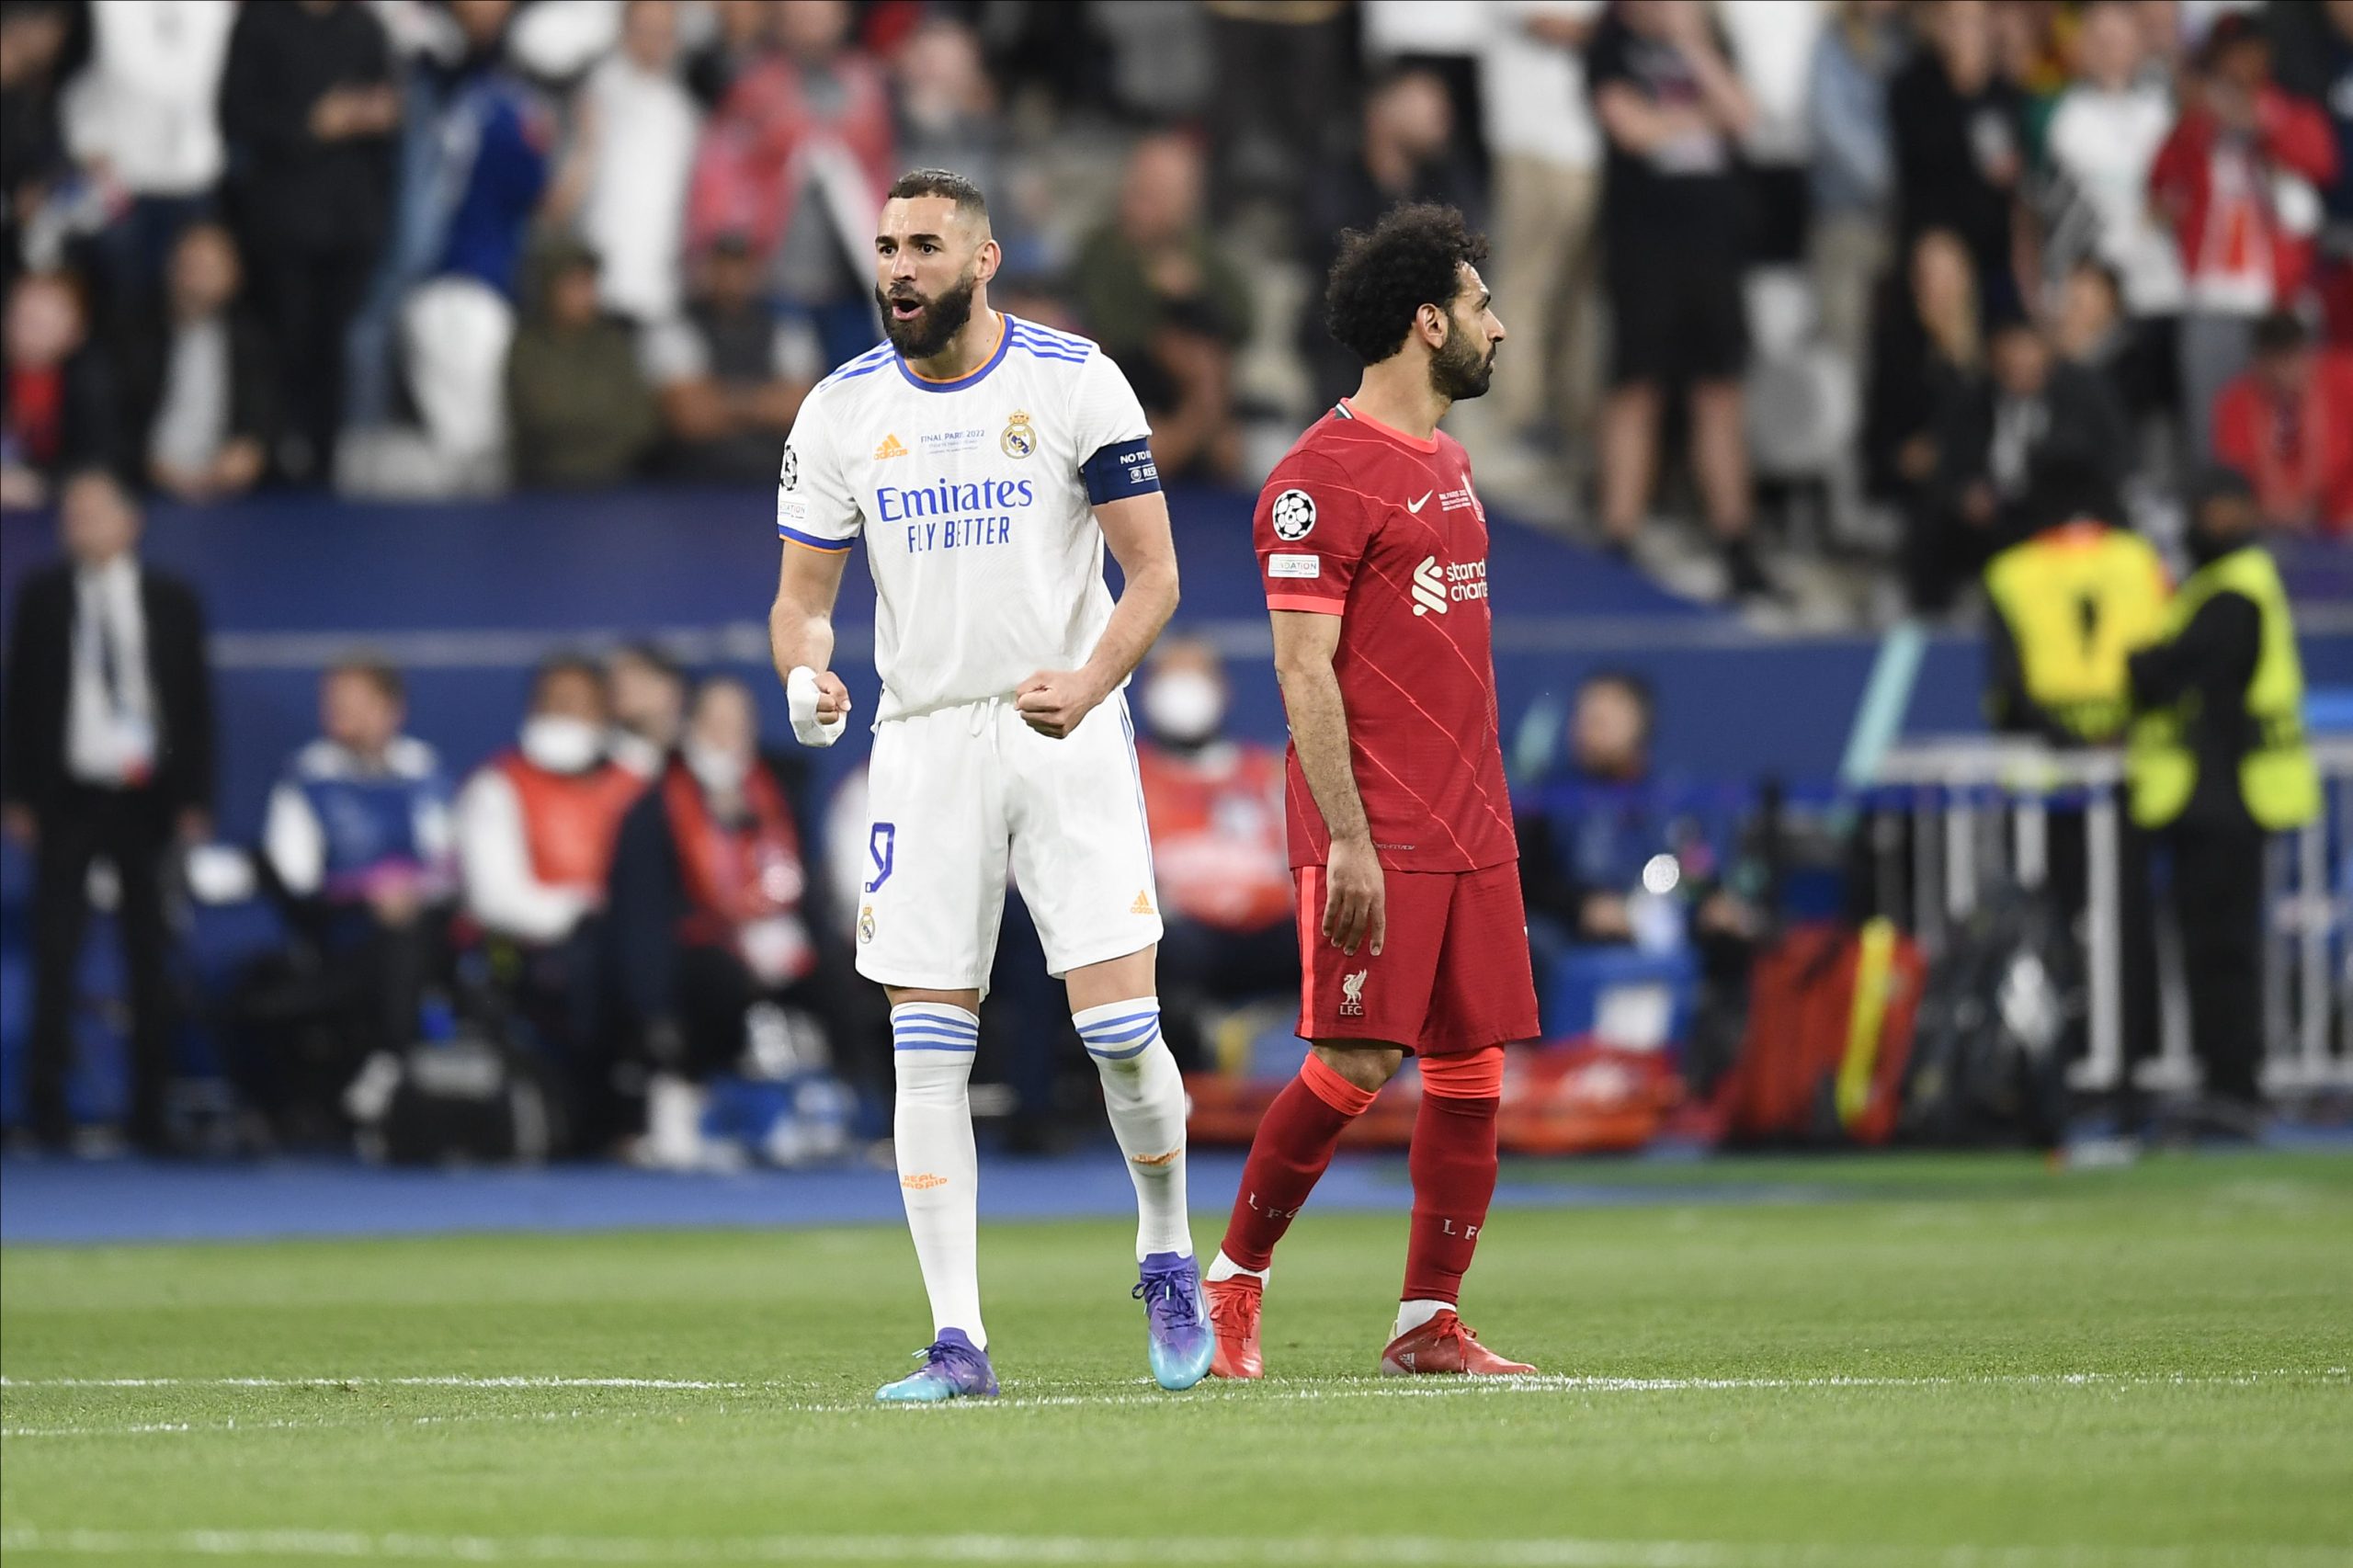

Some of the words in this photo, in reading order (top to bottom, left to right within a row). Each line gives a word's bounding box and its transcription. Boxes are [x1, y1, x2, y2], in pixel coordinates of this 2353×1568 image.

[920, 435, 942, 443] FINAL
[966, 429, 984, 438] 2022
[1120, 453, 1137, 464] NO
[1136, 450, 1146, 461] TO
[877, 477, 1032, 522] Emirates
[907, 522, 937, 553] FLY
[944, 516, 1010, 549] BETTER
[865, 822, 895, 892] 9
[904, 1174, 937, 1183] REAL
